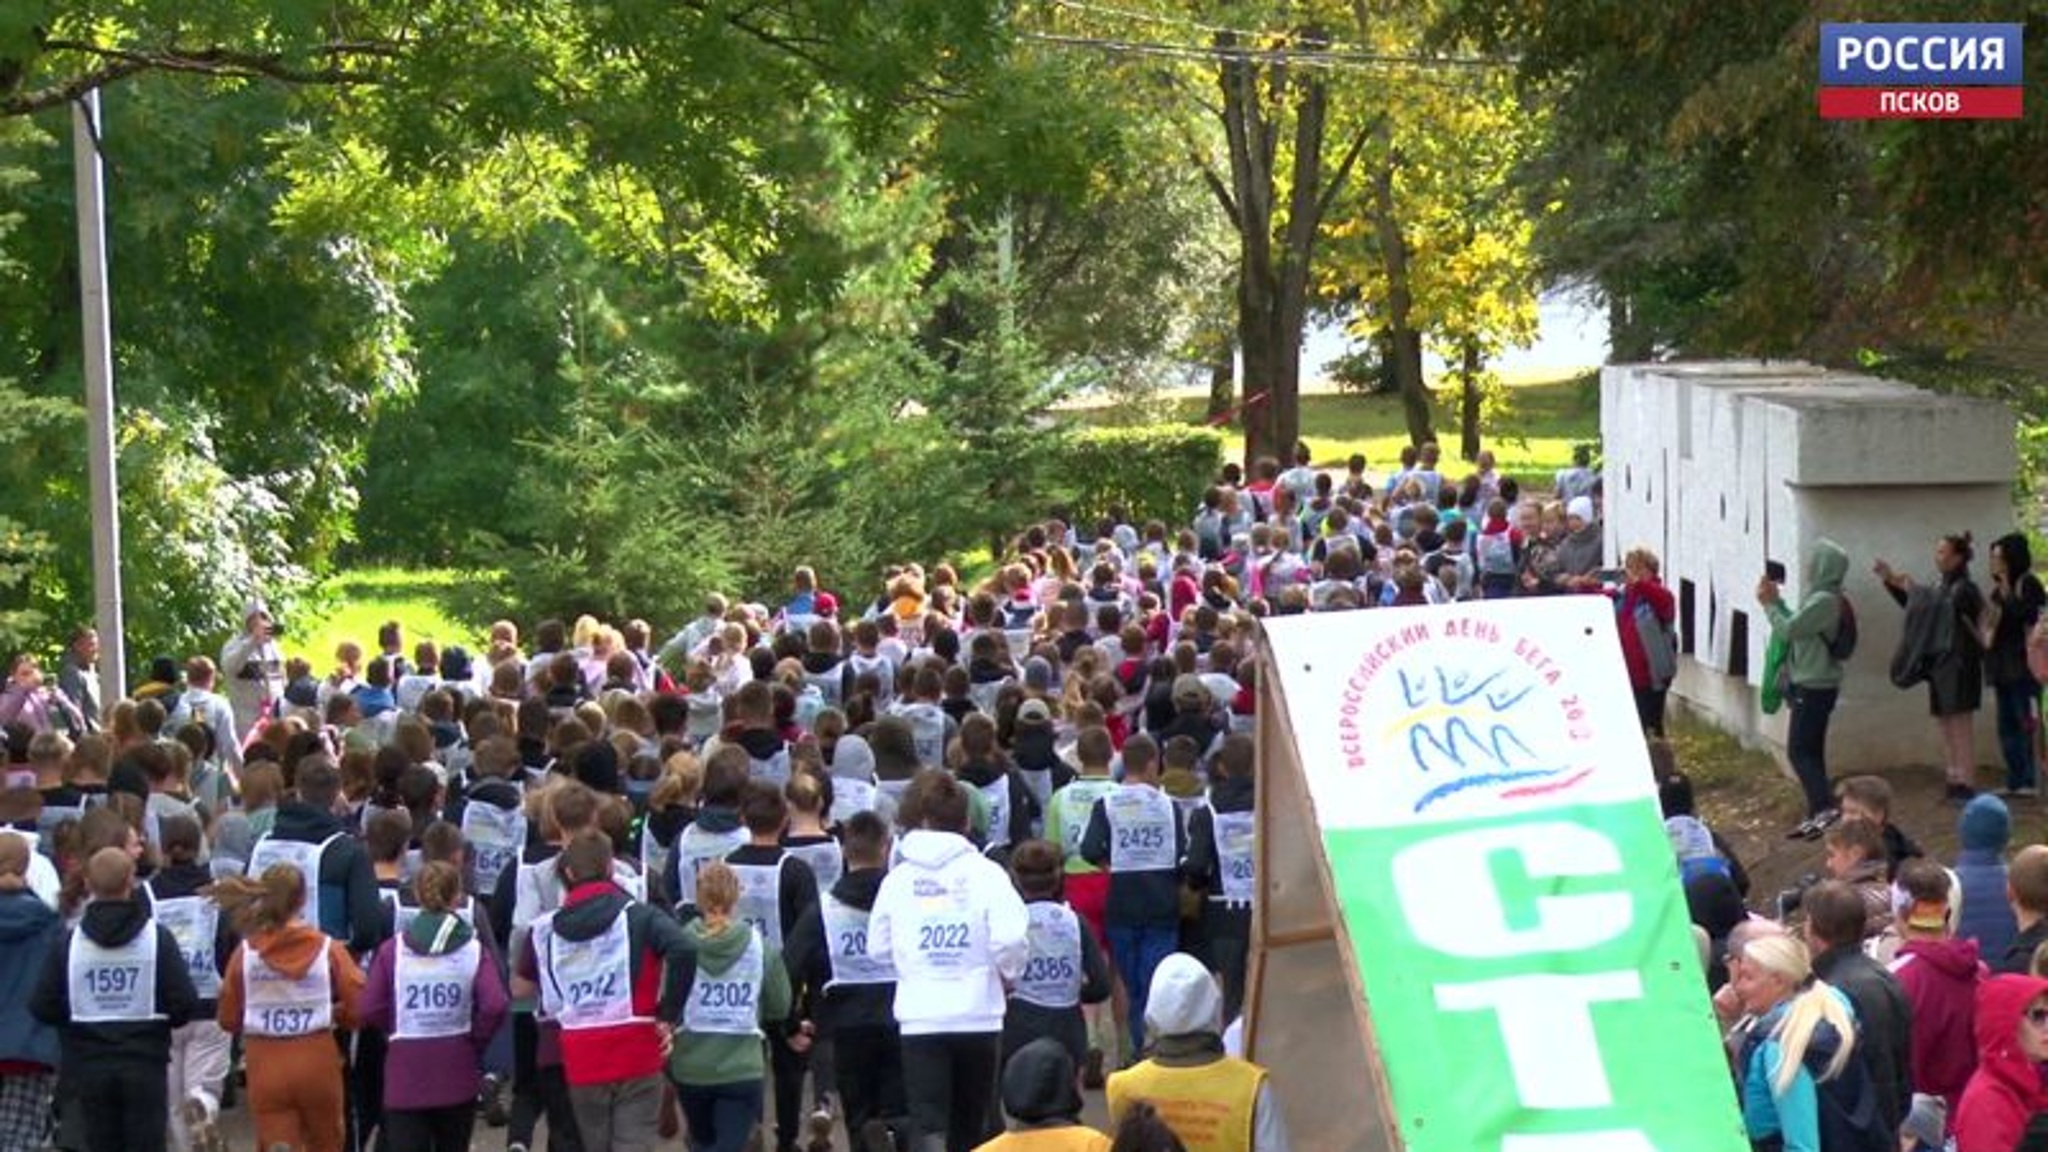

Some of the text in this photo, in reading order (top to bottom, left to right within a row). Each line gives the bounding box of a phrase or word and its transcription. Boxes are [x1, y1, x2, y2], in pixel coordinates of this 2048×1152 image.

[1444, 618, 1500, 643] ДЕНЬ
[1514, 637, 1562, 685] БЕГА
[1117, 826, 1164, 849] 2425
[918, 922, 971, 950] 2022
[84, 967, 141, 993] 1597
[1022, 957, 1074, 981] 2386
[405, 982, 462, 1009] 2169
[700, 982, 752, 1007] 2302
[1391, 821, 1656, 1152] СТ
[261, 1008, 314, 1032] 1637
